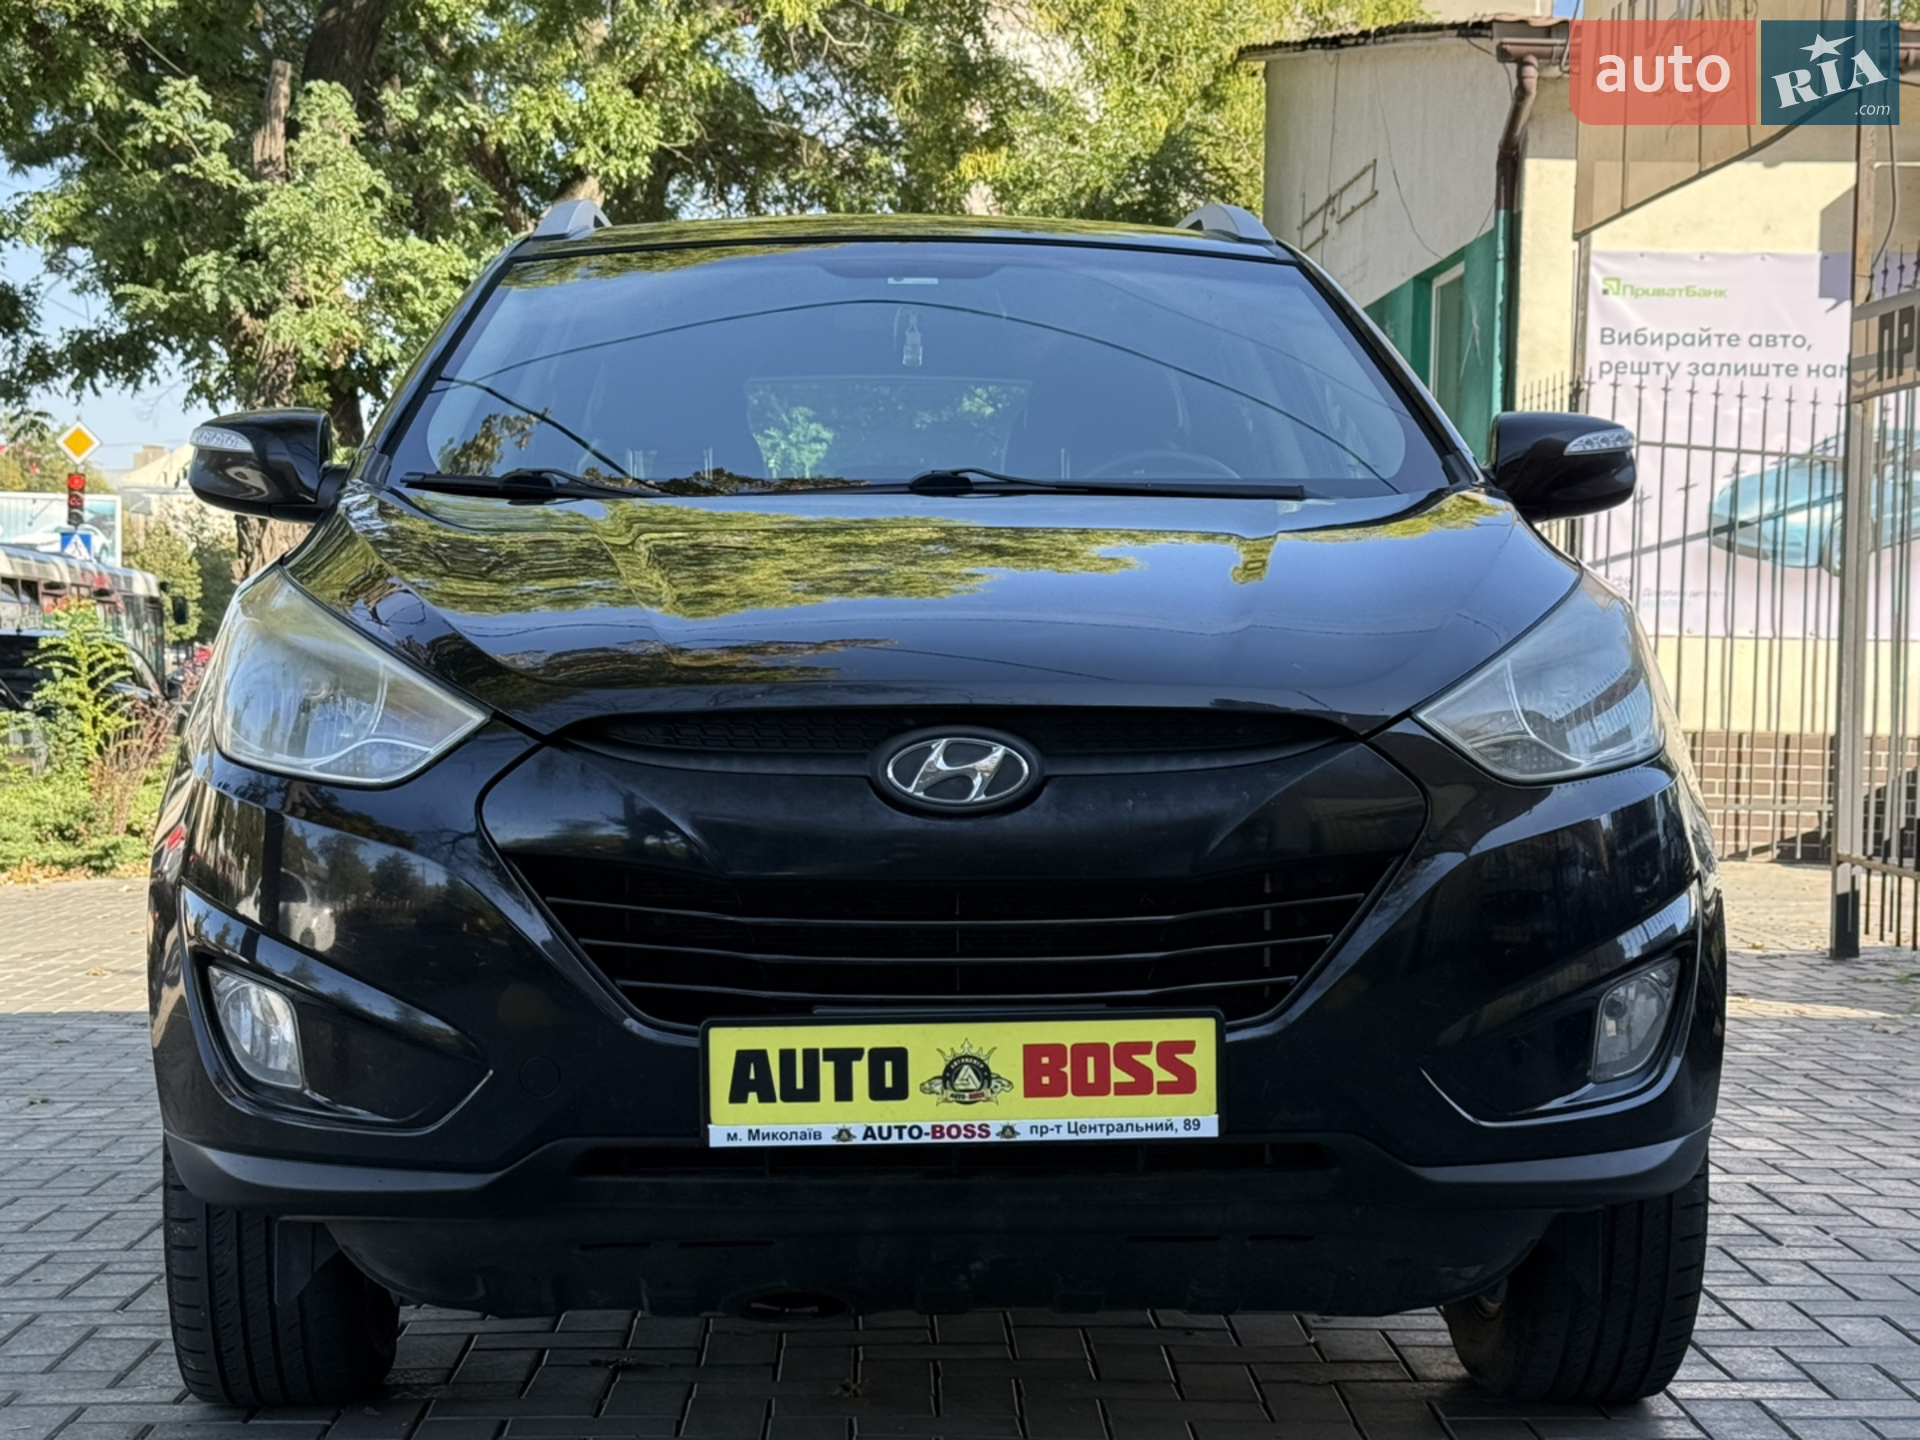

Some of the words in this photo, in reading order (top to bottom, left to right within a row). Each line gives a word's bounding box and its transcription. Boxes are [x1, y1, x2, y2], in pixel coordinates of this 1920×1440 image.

[1622, 284, 1727, 299] ПриватБанк
[1600, 326, 1741, 350] Вибирайте
[1748, 332, 1813, 352] авто,
[1877, 304, 1920, 382] ПР
[1598, 360, 1680, 379] решту
[1687, 362, 1799, 378] залиште
[728, 1046, 910, 1104] AUTO
[1022, 1039, 1198, 1099] BOSS
[726, 1132, 743, 1142] м.
[747, 1127, 823, 1142] Миколаїв
[862, 1123, 991, 1142] AUTO-BOSS
[1029, 1122, 1063, 1137] пр-т
[1067, 1118, 1178, 1136] Центральний,
[1183, 1118, 1201, 1132] 89
